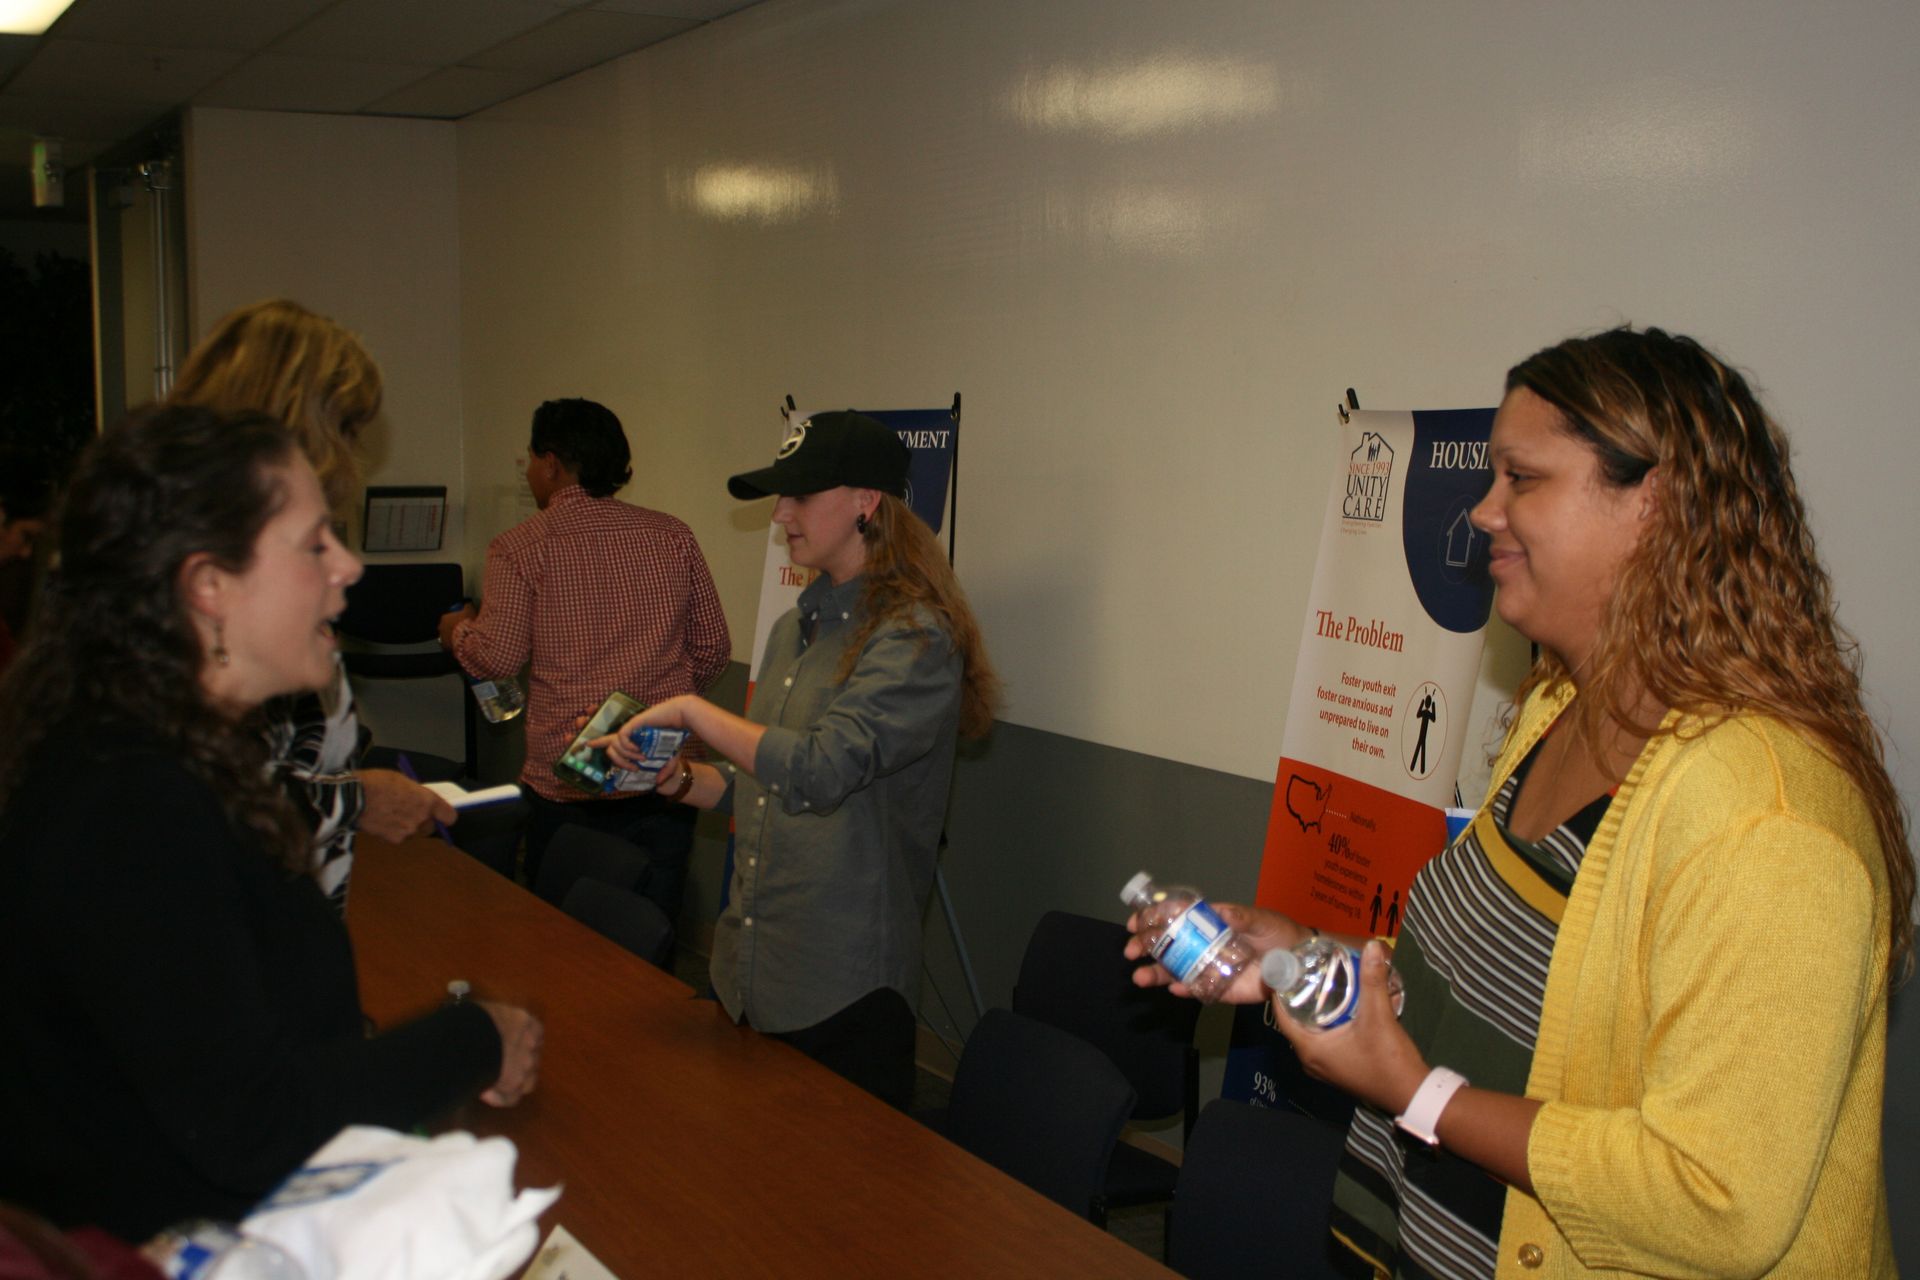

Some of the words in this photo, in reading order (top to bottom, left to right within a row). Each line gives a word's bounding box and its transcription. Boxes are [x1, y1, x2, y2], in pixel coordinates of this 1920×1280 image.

[1349, 462, 1371, 475] SINCE
[1371, 461, 1391, 475] 1993
[1429, 441, 1489, 470] HOUSI
[1346, 474, 1388, 497] UNITY
[1342, 495, 1383, 518] CARE
[779, 566, 804, 587] The
[1316, 610, 1342, 640] The
[1344, 615, 1404, 653] Problem
[1341, 672, 1362, 688] Foster
[1361, 680, 1382, 694] youth
[1383, 683, 1397, 697] exit
[1317, 686, 1338, 702] foster
[1338, 694, 1352, 706] care
[1352, 698, 1379, 714] anxious
[1378, 703, 1393, 718] and
[1320, 709, 1359, 729] unprepared
[1359, 719, 1367, 731] to
[1366, 720, 1380, 736] live
[1380, 727, 1389, 738] on
[1352, 737, 1368, 753] their
[1369, 745, 1386, 759] own.
[1328, 833, 1350, 859] 40%
[1253, 1071, 1276, 1102] 93%
